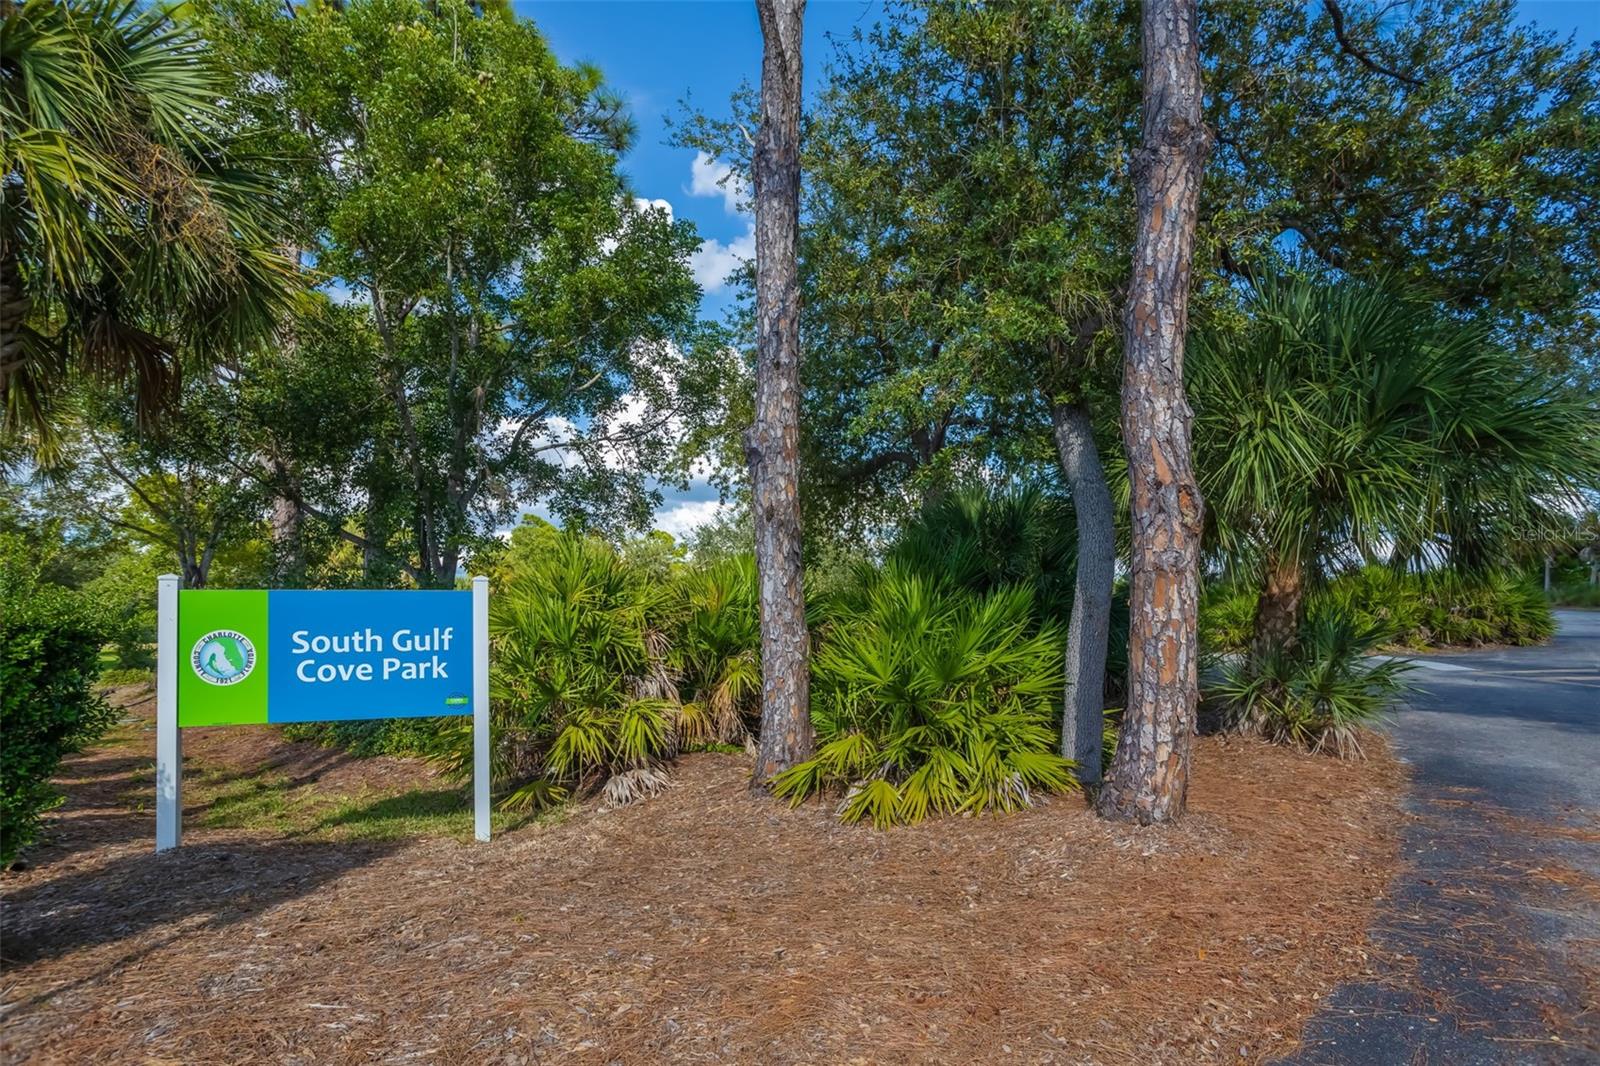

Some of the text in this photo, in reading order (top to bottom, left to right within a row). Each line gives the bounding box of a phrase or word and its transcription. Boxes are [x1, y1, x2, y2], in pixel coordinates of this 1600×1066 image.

[202, 631, 245, 644] CHARLOTTE
[292, 627, 454, 654] South Gulf
[296, 655, 449, 683] Cove Park
